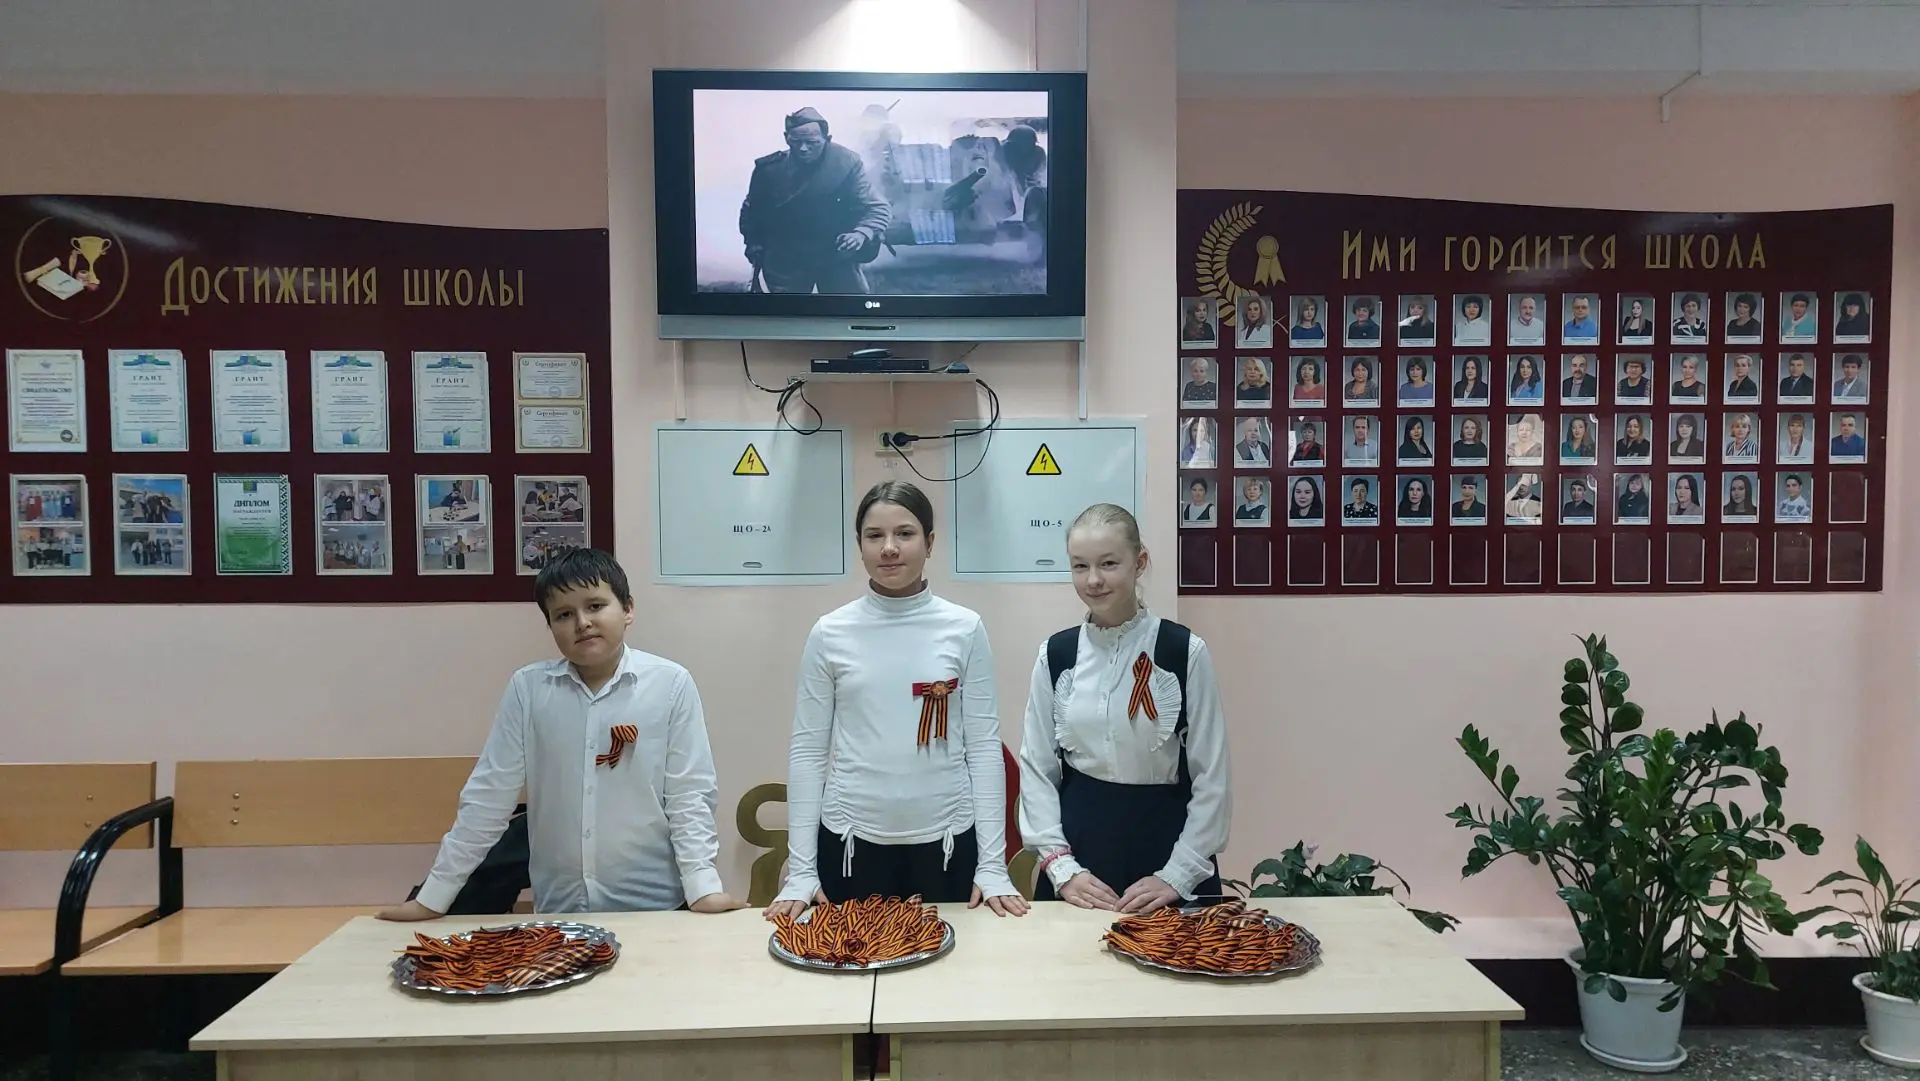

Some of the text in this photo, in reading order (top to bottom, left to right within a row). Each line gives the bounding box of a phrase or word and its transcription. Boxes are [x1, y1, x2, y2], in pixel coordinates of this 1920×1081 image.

[1342, 228, 1767, 279] Ими гордится школа
[161, 256, 525, 317] Достижения школы
[233, 499, 270, 508] ДИПЛОМ
